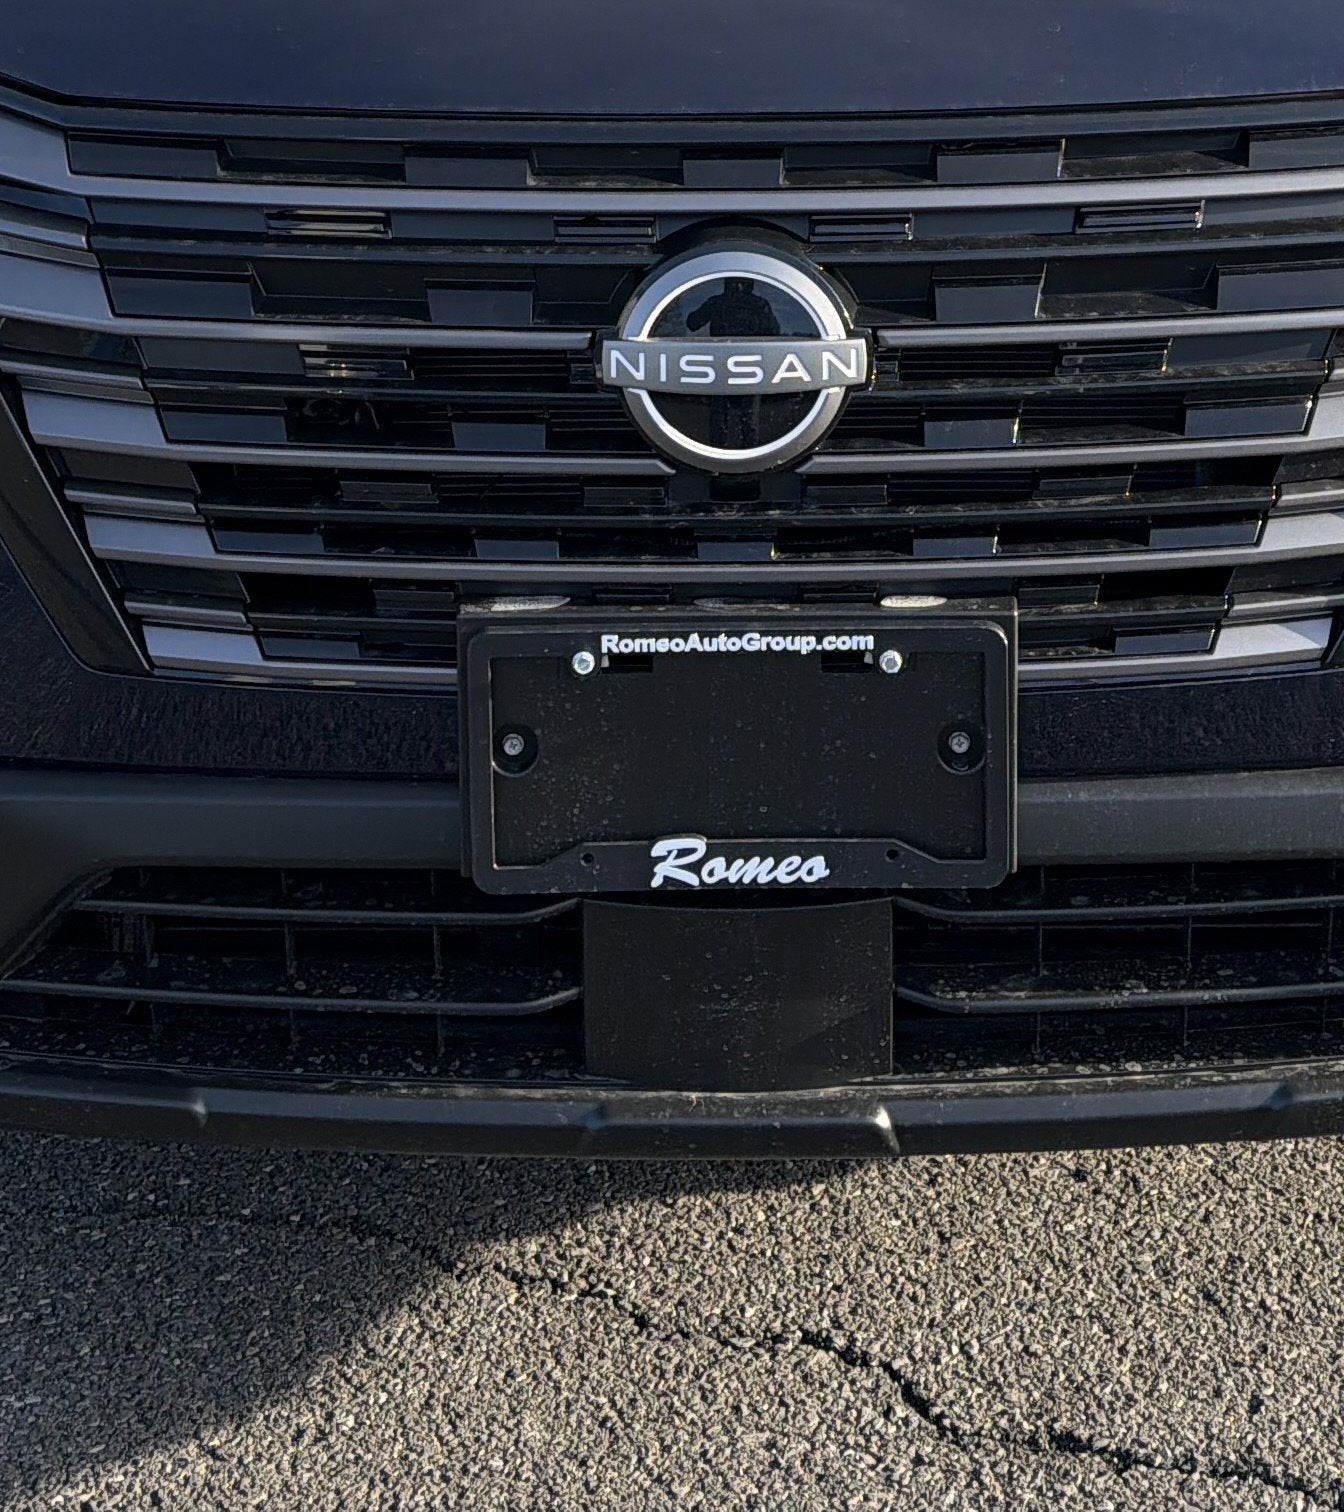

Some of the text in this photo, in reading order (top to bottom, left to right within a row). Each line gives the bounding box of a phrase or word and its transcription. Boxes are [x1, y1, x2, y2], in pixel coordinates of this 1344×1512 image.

[610, 348, 857, 385] NISSAN
[601, 632, 874, 655] RomeoAutoGroup.com
[650, 837, 830, 888] Romeo
